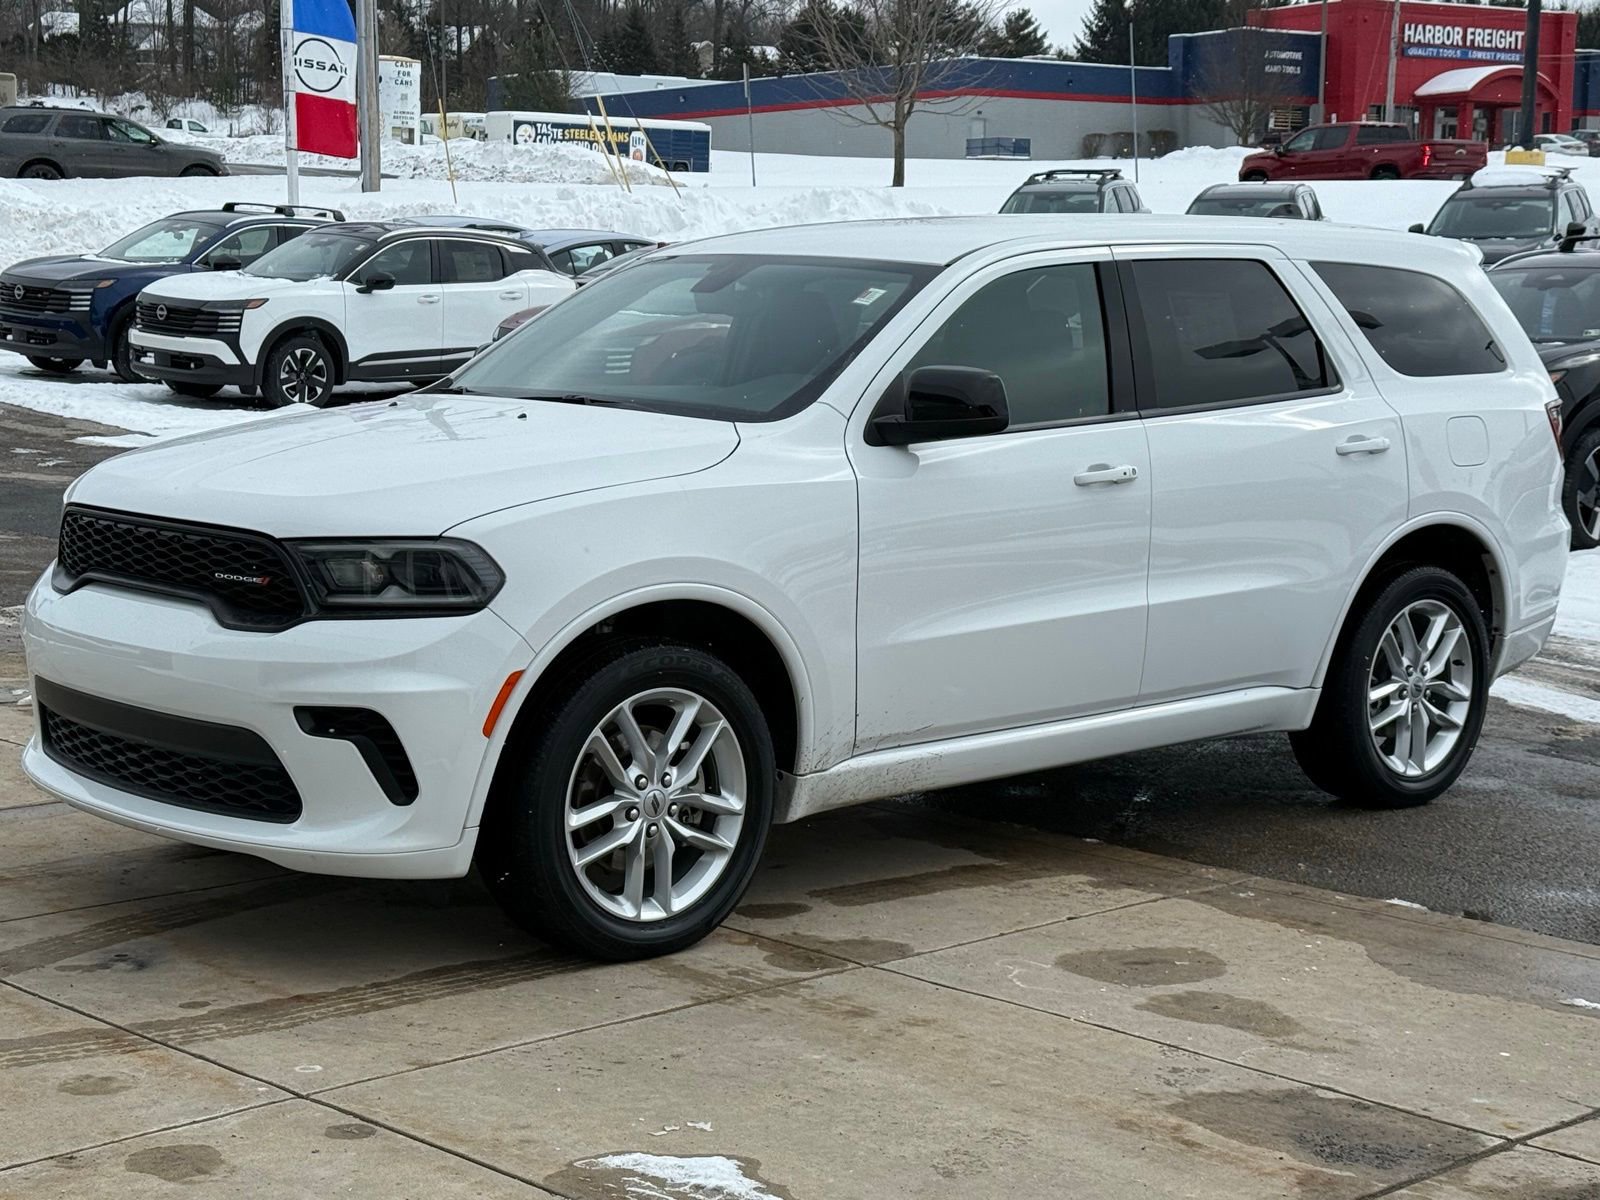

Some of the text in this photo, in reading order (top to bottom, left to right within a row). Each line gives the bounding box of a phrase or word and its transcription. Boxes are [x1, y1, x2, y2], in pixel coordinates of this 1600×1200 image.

[1404, 23, 1526, 50] HARBOR FREIGHT
[1408, 47, 1520, 61] QUALITY TOOLS LOWEST PRICES
[394, 79, 413, 87] CANS
[631, 136, 645, 148] Lite
[214, 572, 264, 584] DODGE
